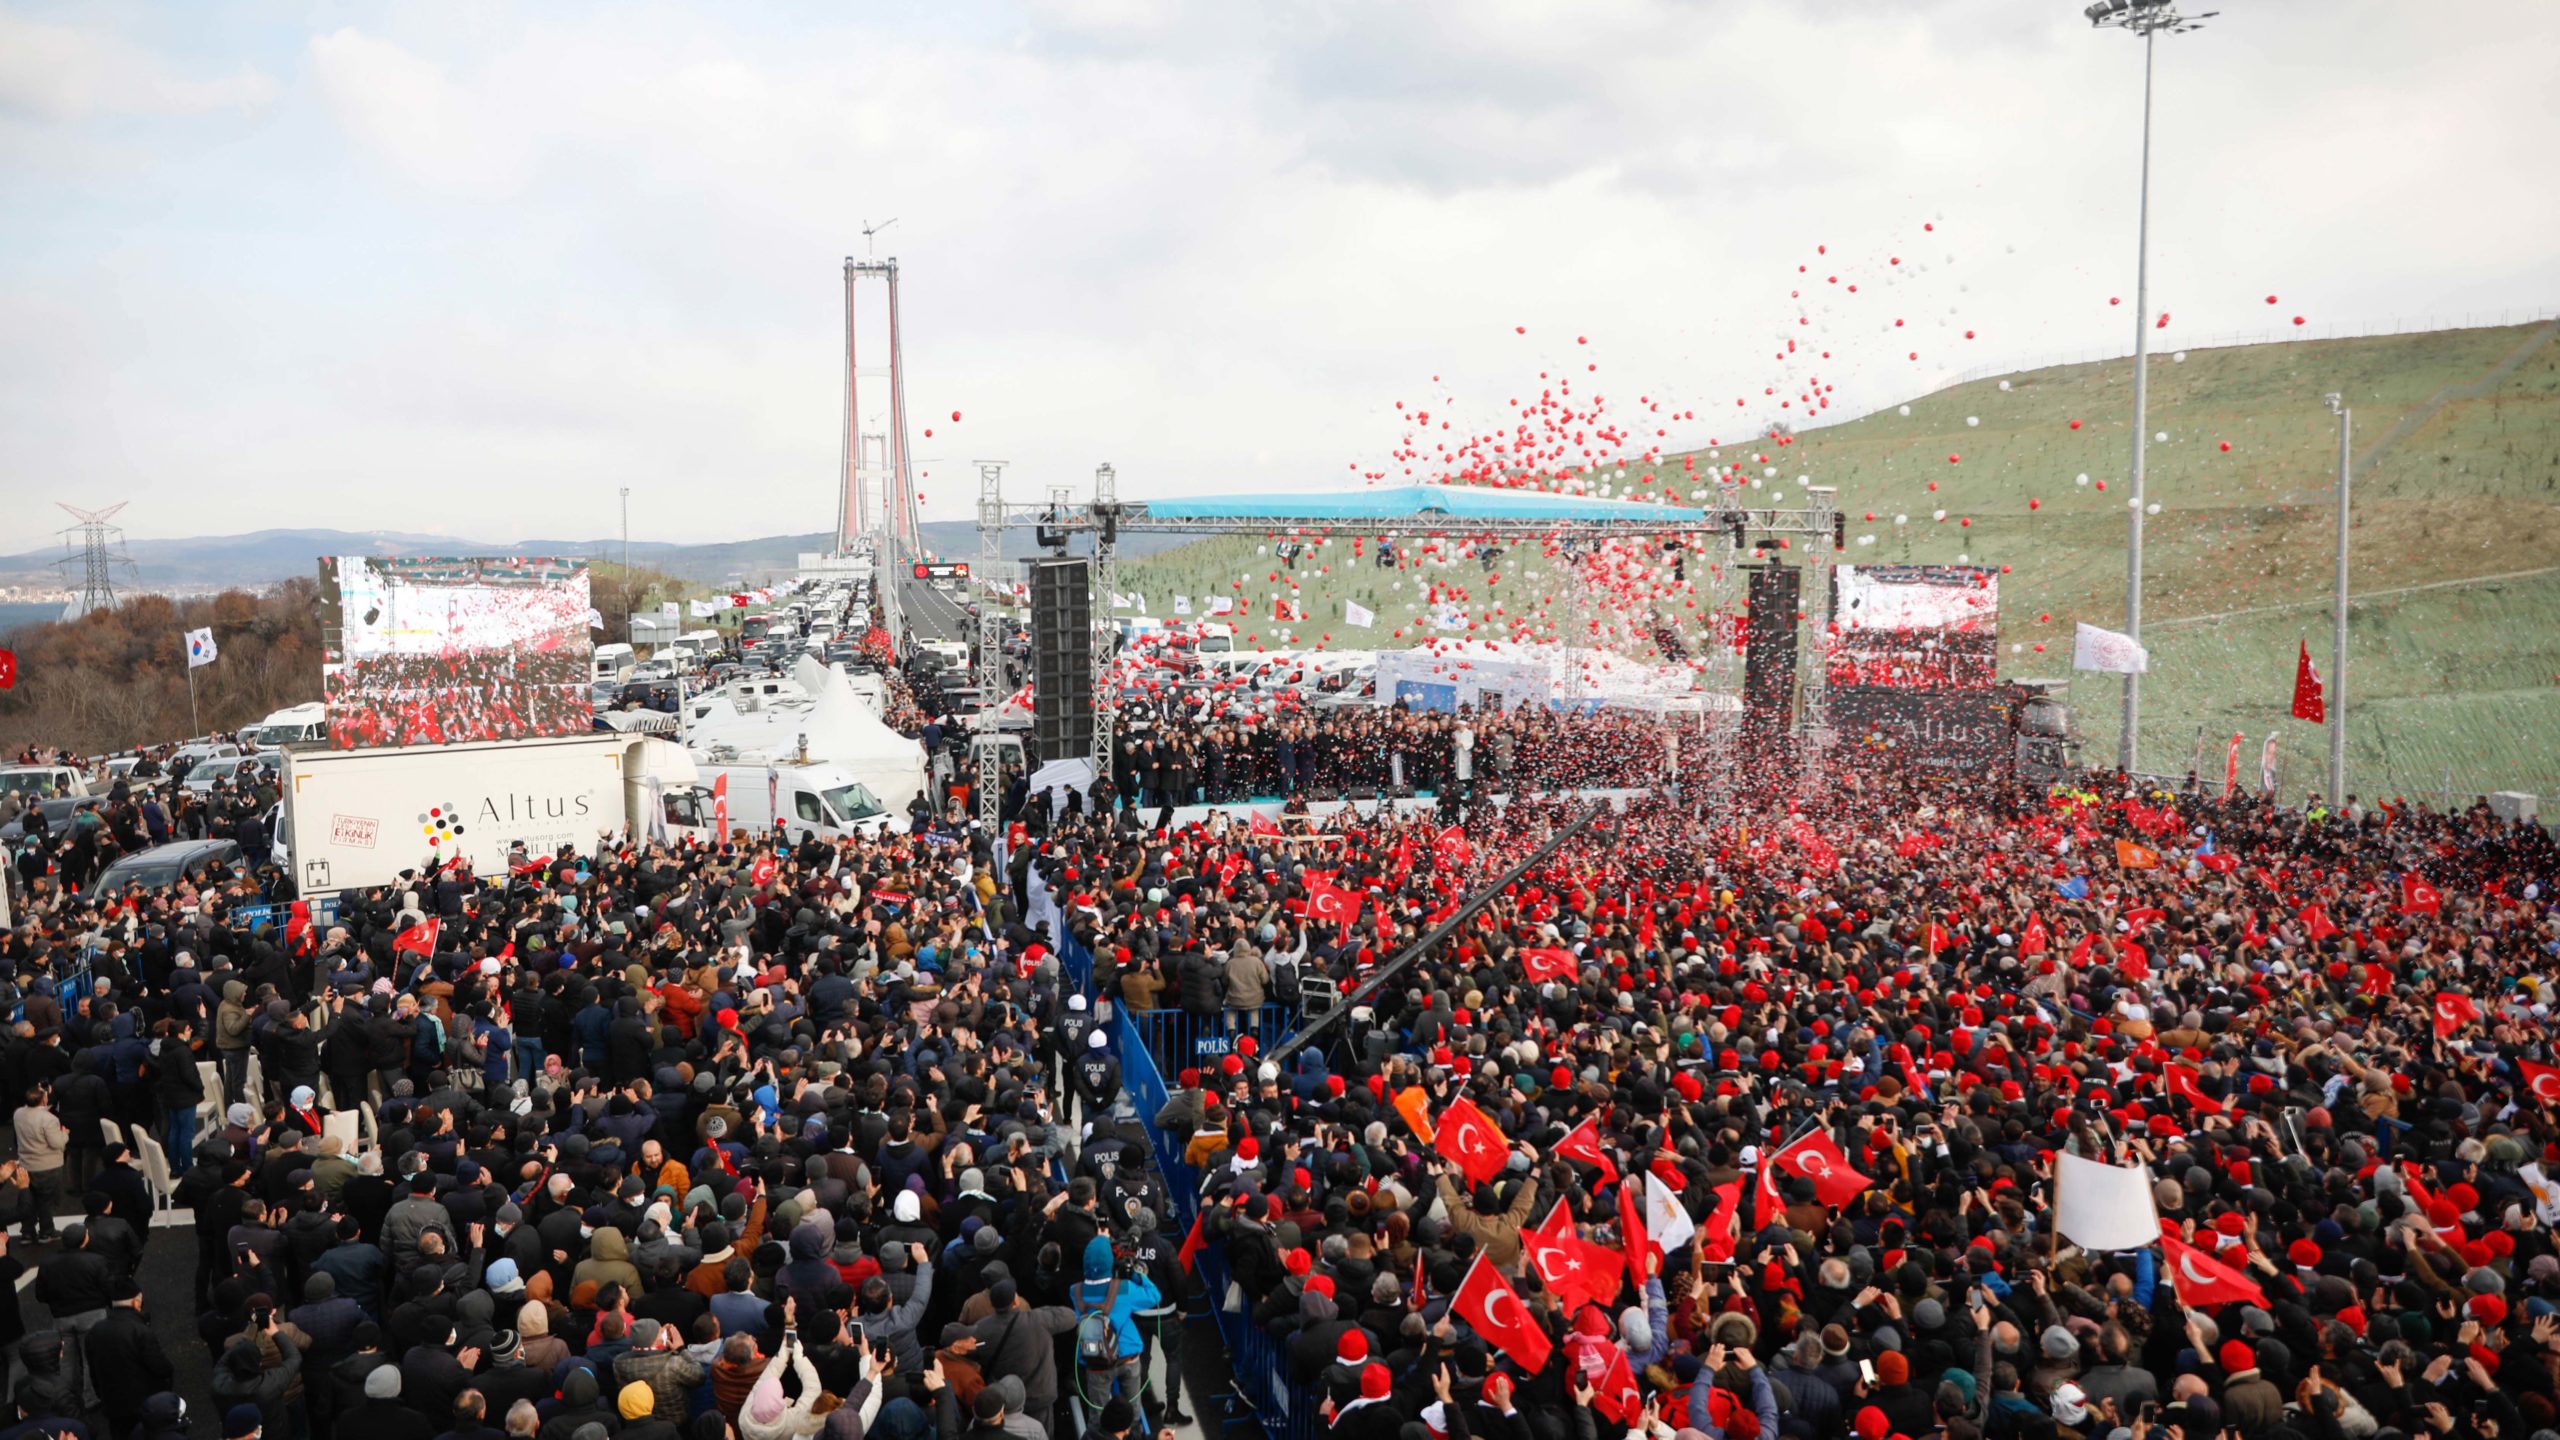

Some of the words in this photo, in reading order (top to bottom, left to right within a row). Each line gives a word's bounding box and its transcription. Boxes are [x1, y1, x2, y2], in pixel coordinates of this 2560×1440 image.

[1902, 718, 1986, 743] Altus
[478, 793, 589, 823] Altus
[496, 832, 574, 845] wwwaltusorg.com
[497, 843, 544, 857] MIL
[1197, 1037, 1229, 1054] POLİS
[1135, 1248, 1156, 1260] LIS
